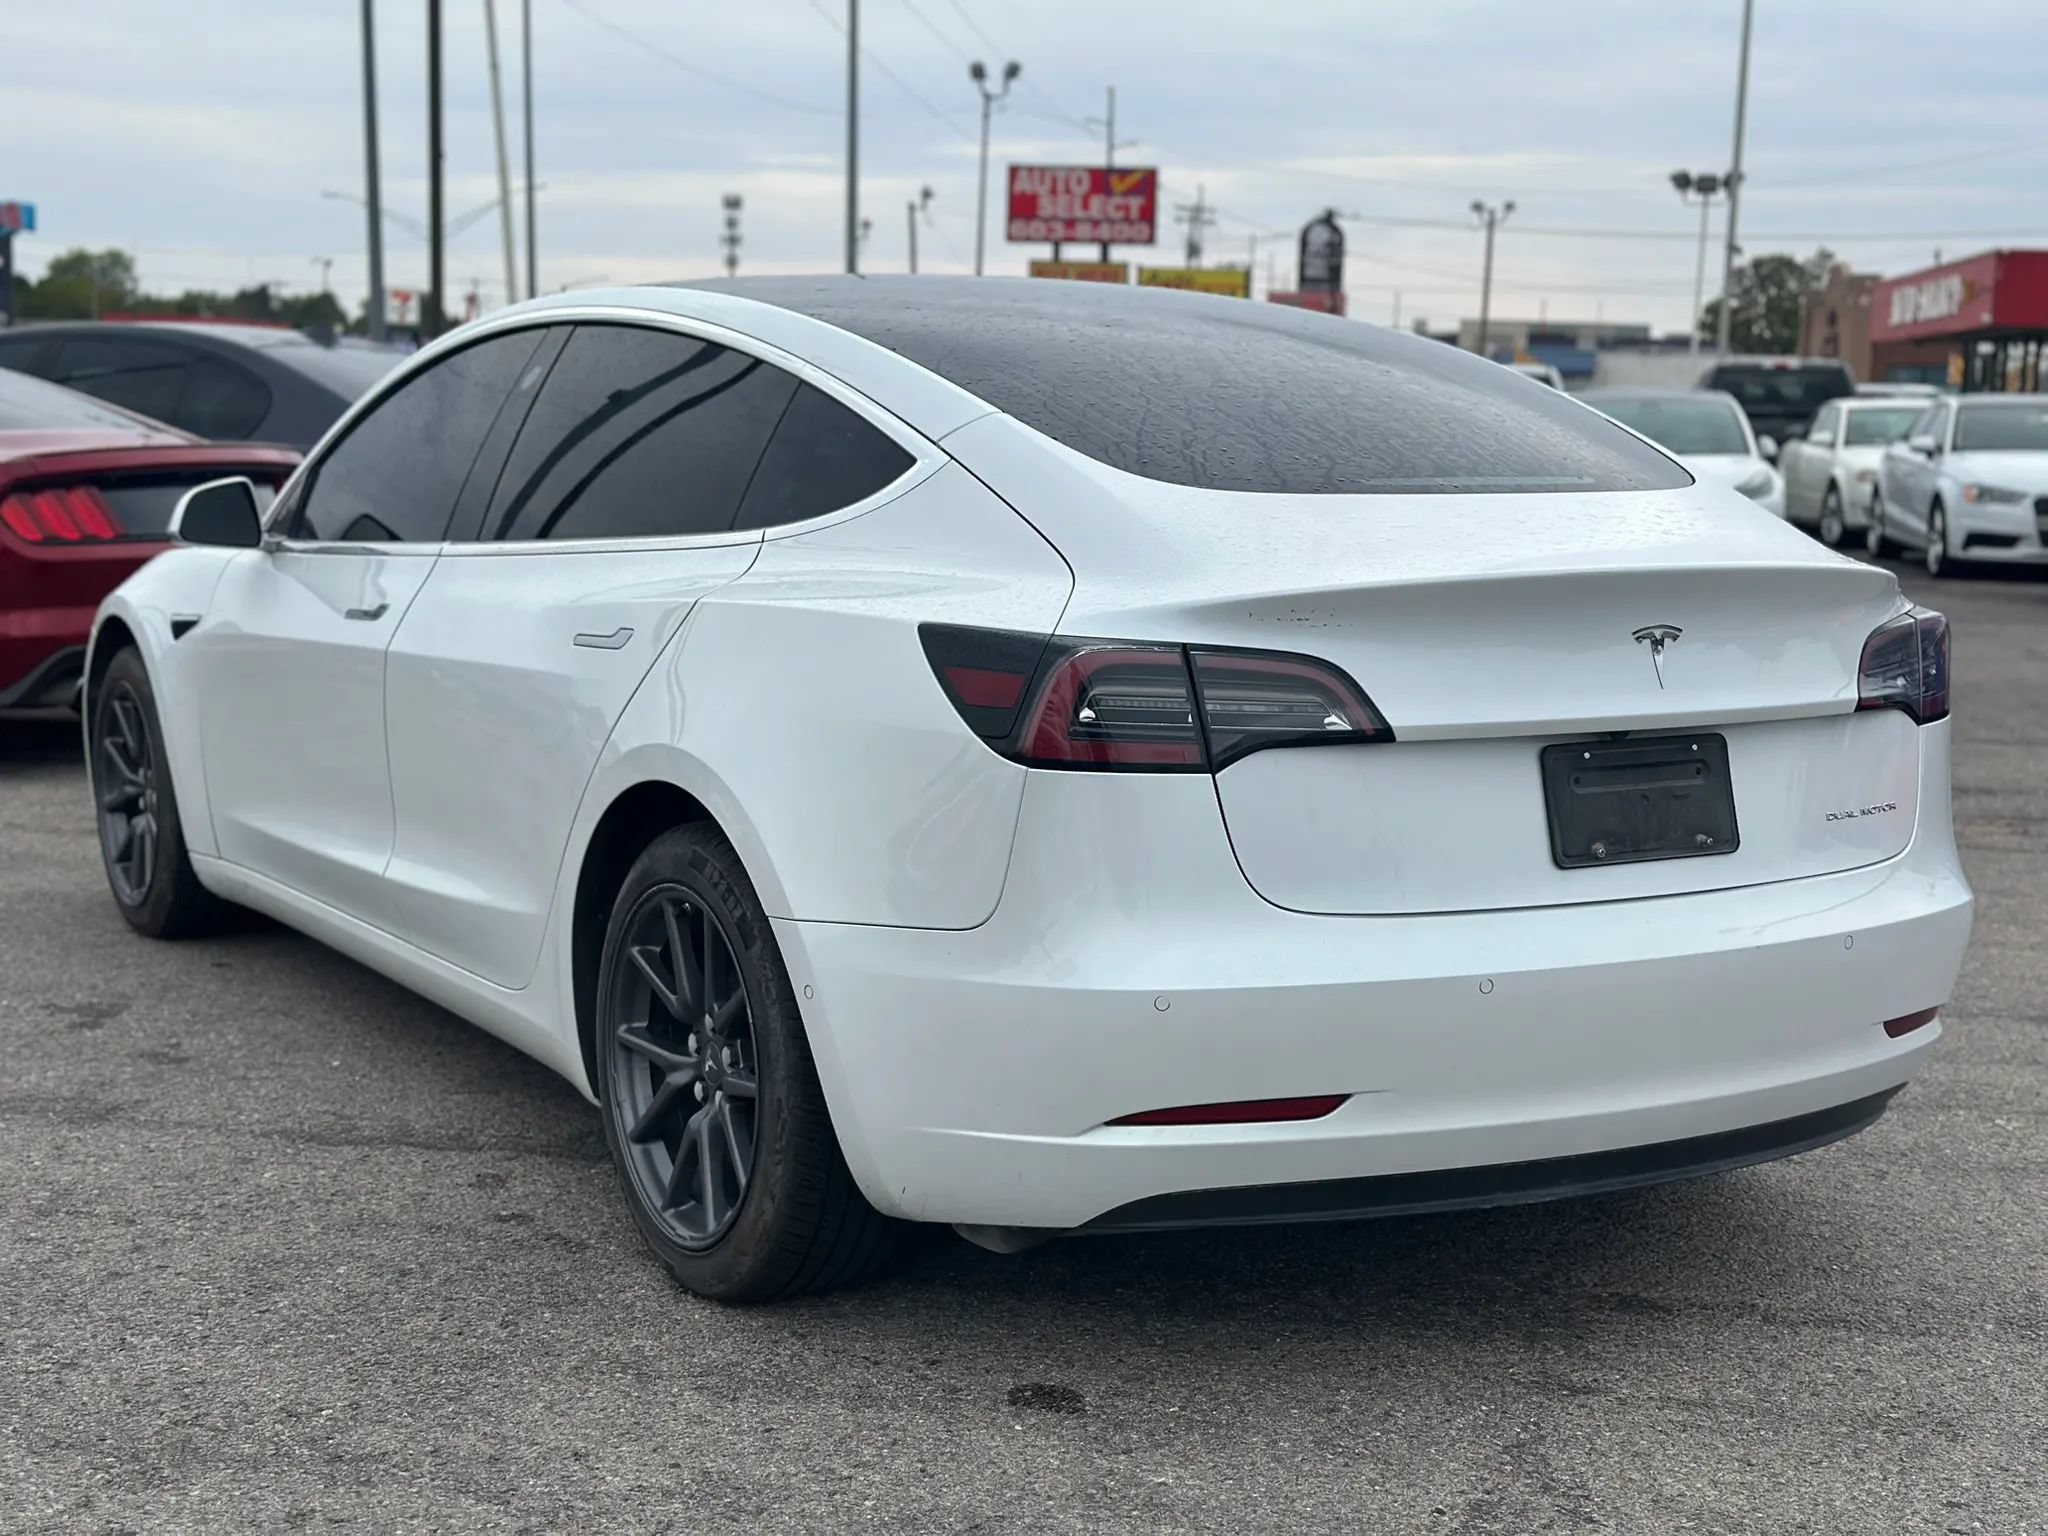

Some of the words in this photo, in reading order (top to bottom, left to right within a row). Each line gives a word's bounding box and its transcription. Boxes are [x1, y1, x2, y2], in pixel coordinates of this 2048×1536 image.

[1013, 168, 1091, 196] AUTO
[1036, 194, 1147, 219] SELECT
[1825, 809, 1859, 821] DUAL
[1859, 801, 1897, 817] MOTOR
